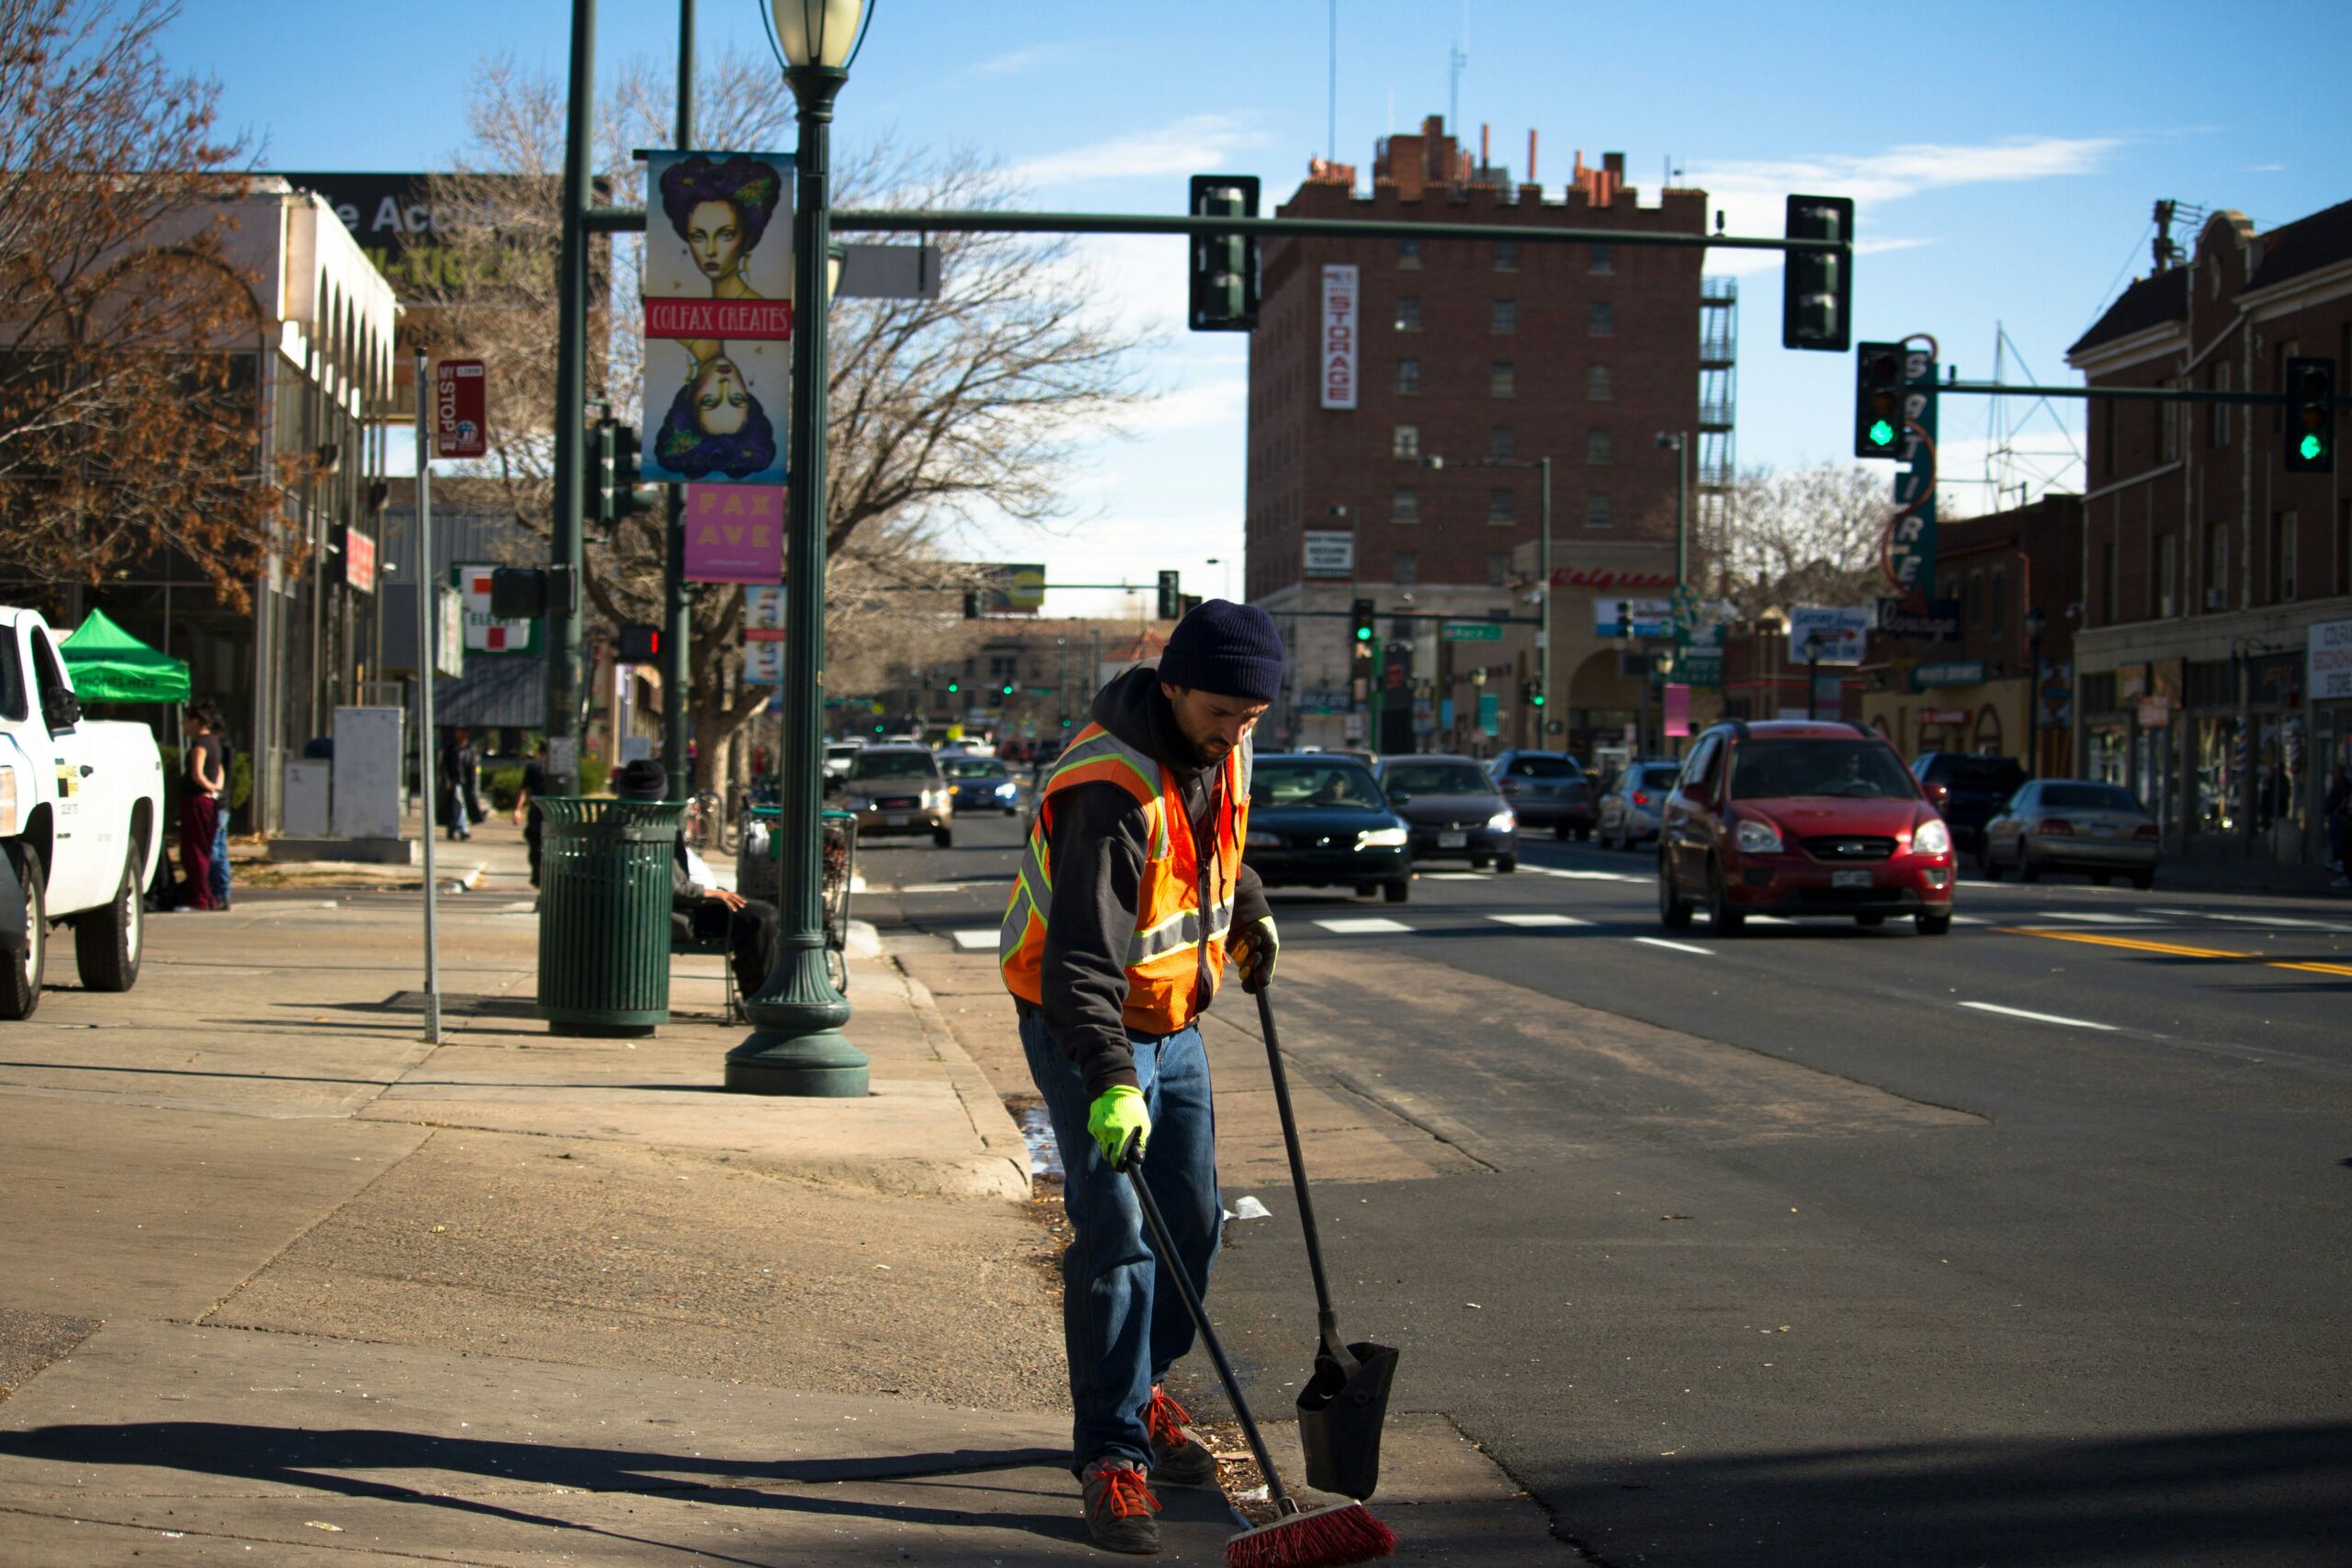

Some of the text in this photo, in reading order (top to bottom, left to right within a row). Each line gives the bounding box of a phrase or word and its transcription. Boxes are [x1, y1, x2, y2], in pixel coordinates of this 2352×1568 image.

[652, 305, 788, 332] COLFAX CREATES
[1328, 296, 1351, 400] STORAGE
[440, 380, 457, 432] STOP
[698, 492, 772, 516] FAX
[696, 524, 773, 548] AVE
